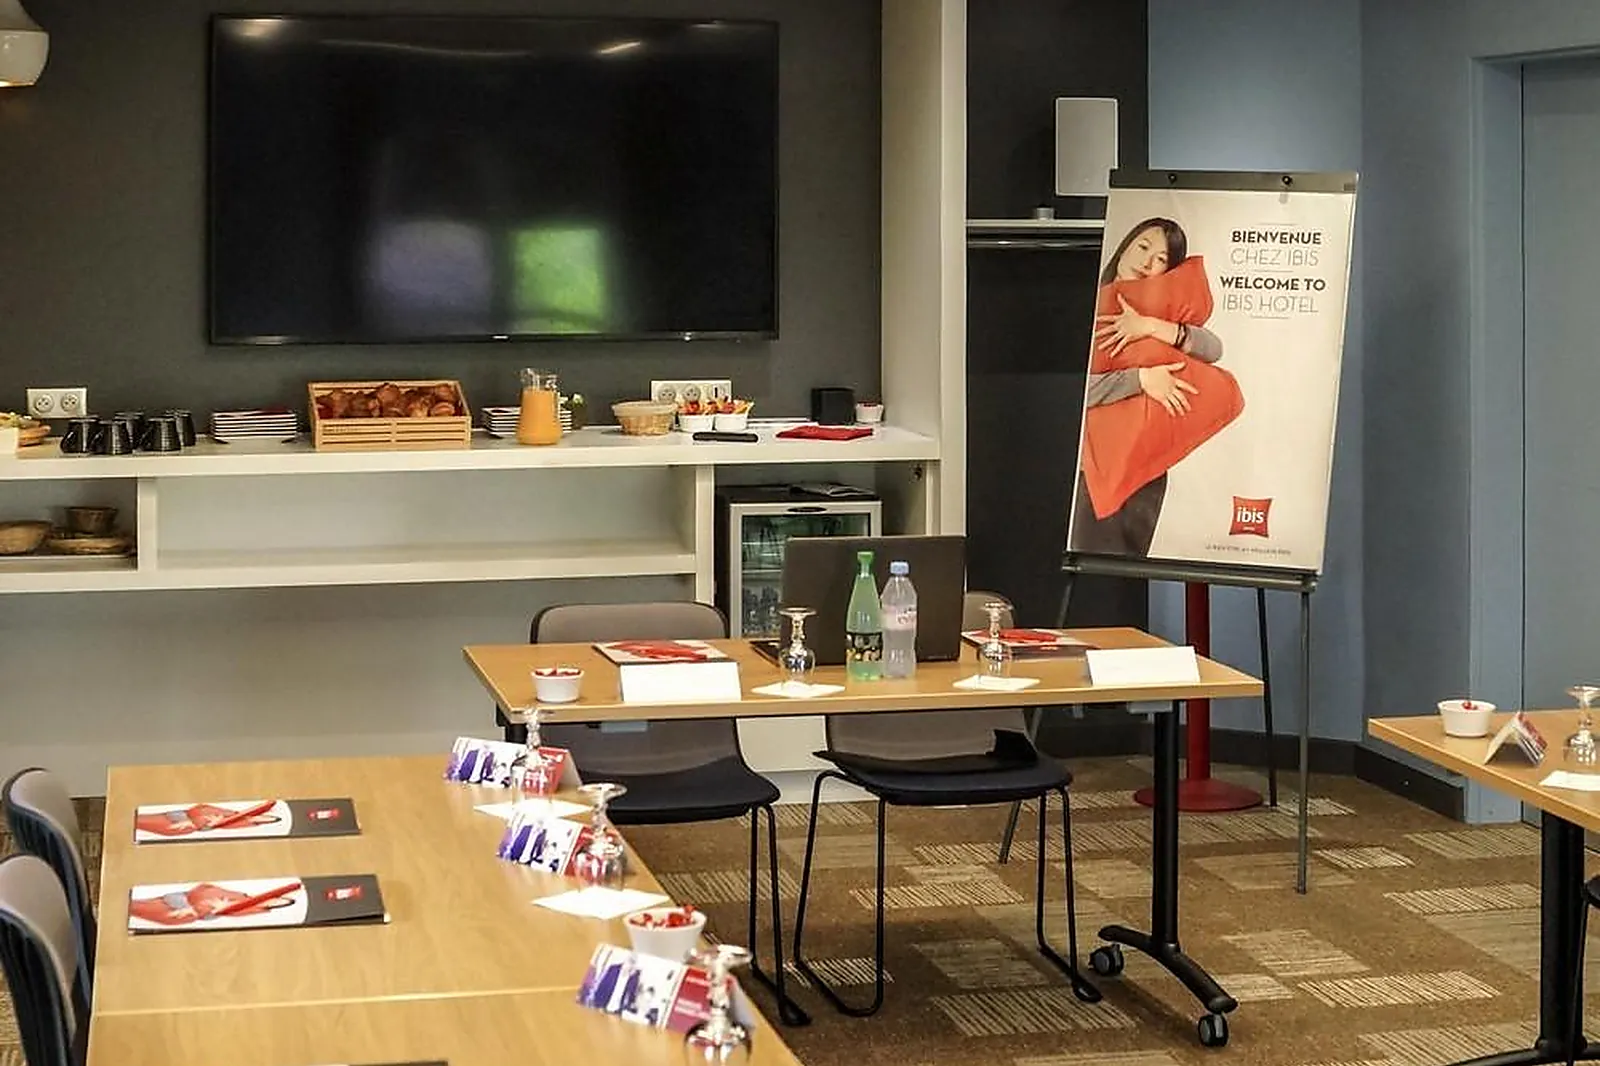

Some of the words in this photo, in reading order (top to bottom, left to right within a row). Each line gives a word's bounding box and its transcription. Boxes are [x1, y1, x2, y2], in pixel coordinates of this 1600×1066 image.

[1231, 231, 1322, 245] BIENVENUE
[1230, 248, 1281, 265] CHEZ
[1287, 249, 1319, 267] IBIS
[1220, 276, 1299, 291] WELCOME
[1304, 278, 1326, 291] TO
[1222, 294, 1254, 312] IBIS
[1259, 296, 1319, 313] HOTEL
[1236, 506, 1266, 524] ibis
